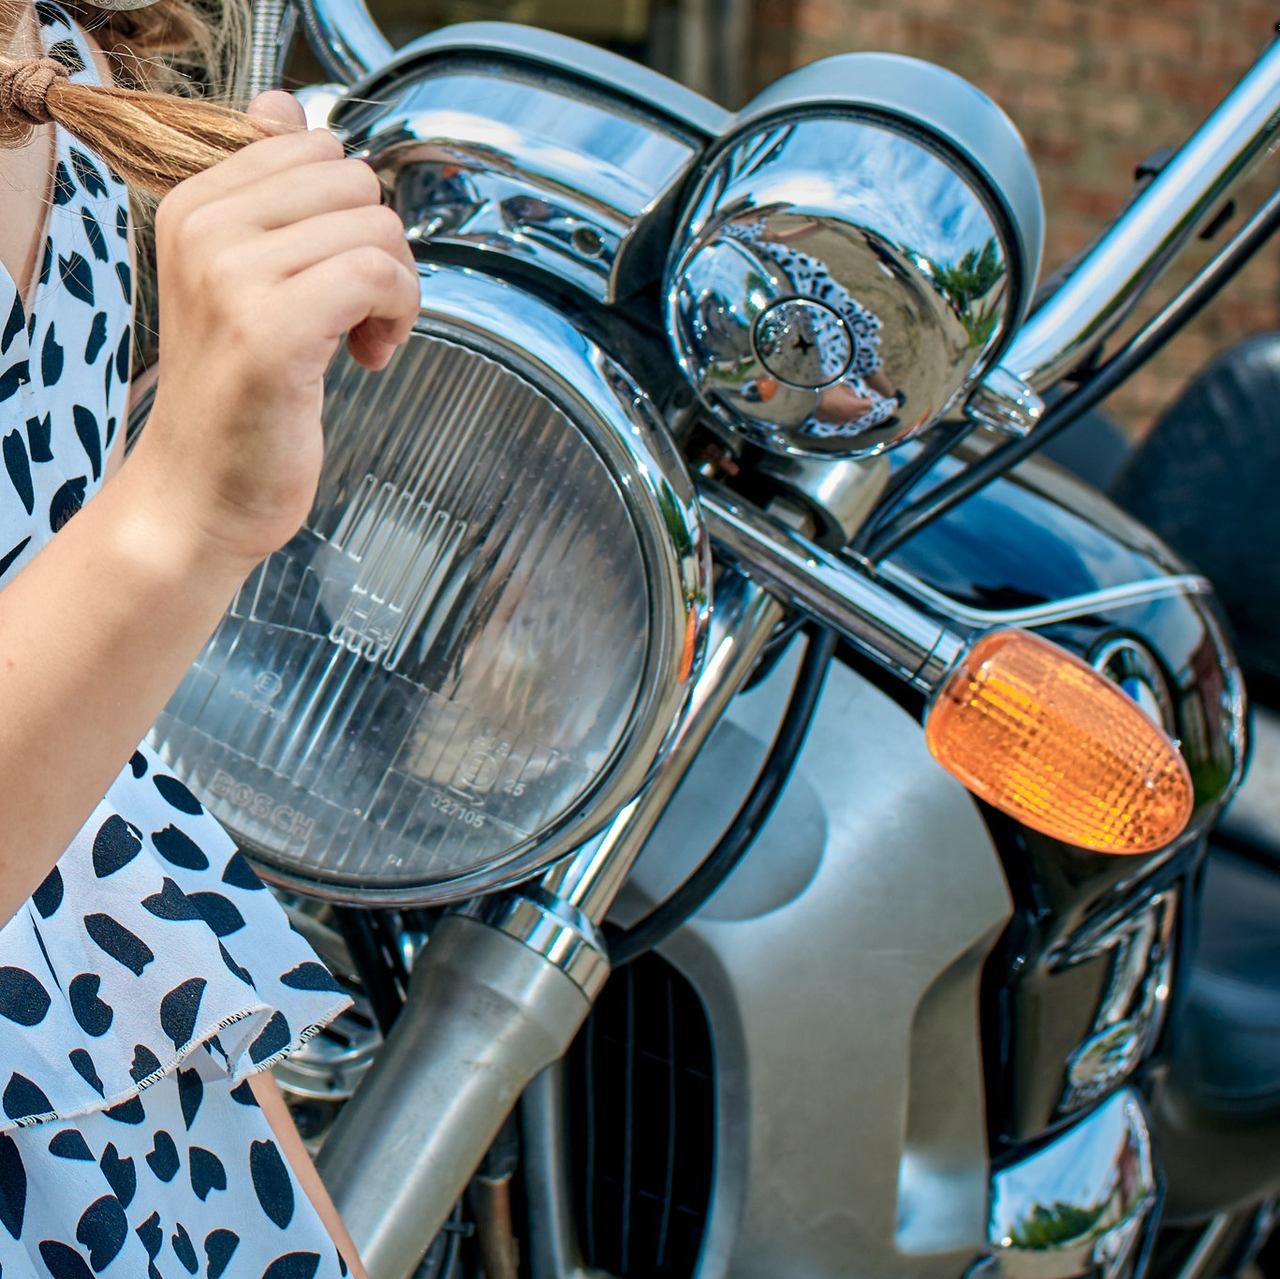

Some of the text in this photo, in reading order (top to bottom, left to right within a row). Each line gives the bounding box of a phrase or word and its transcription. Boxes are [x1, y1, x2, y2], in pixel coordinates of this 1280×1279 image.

[207, 768, 316, 841] BOSCH
[503, 778, 526, 797] 25
[430, 794, 486, 829] 027105
